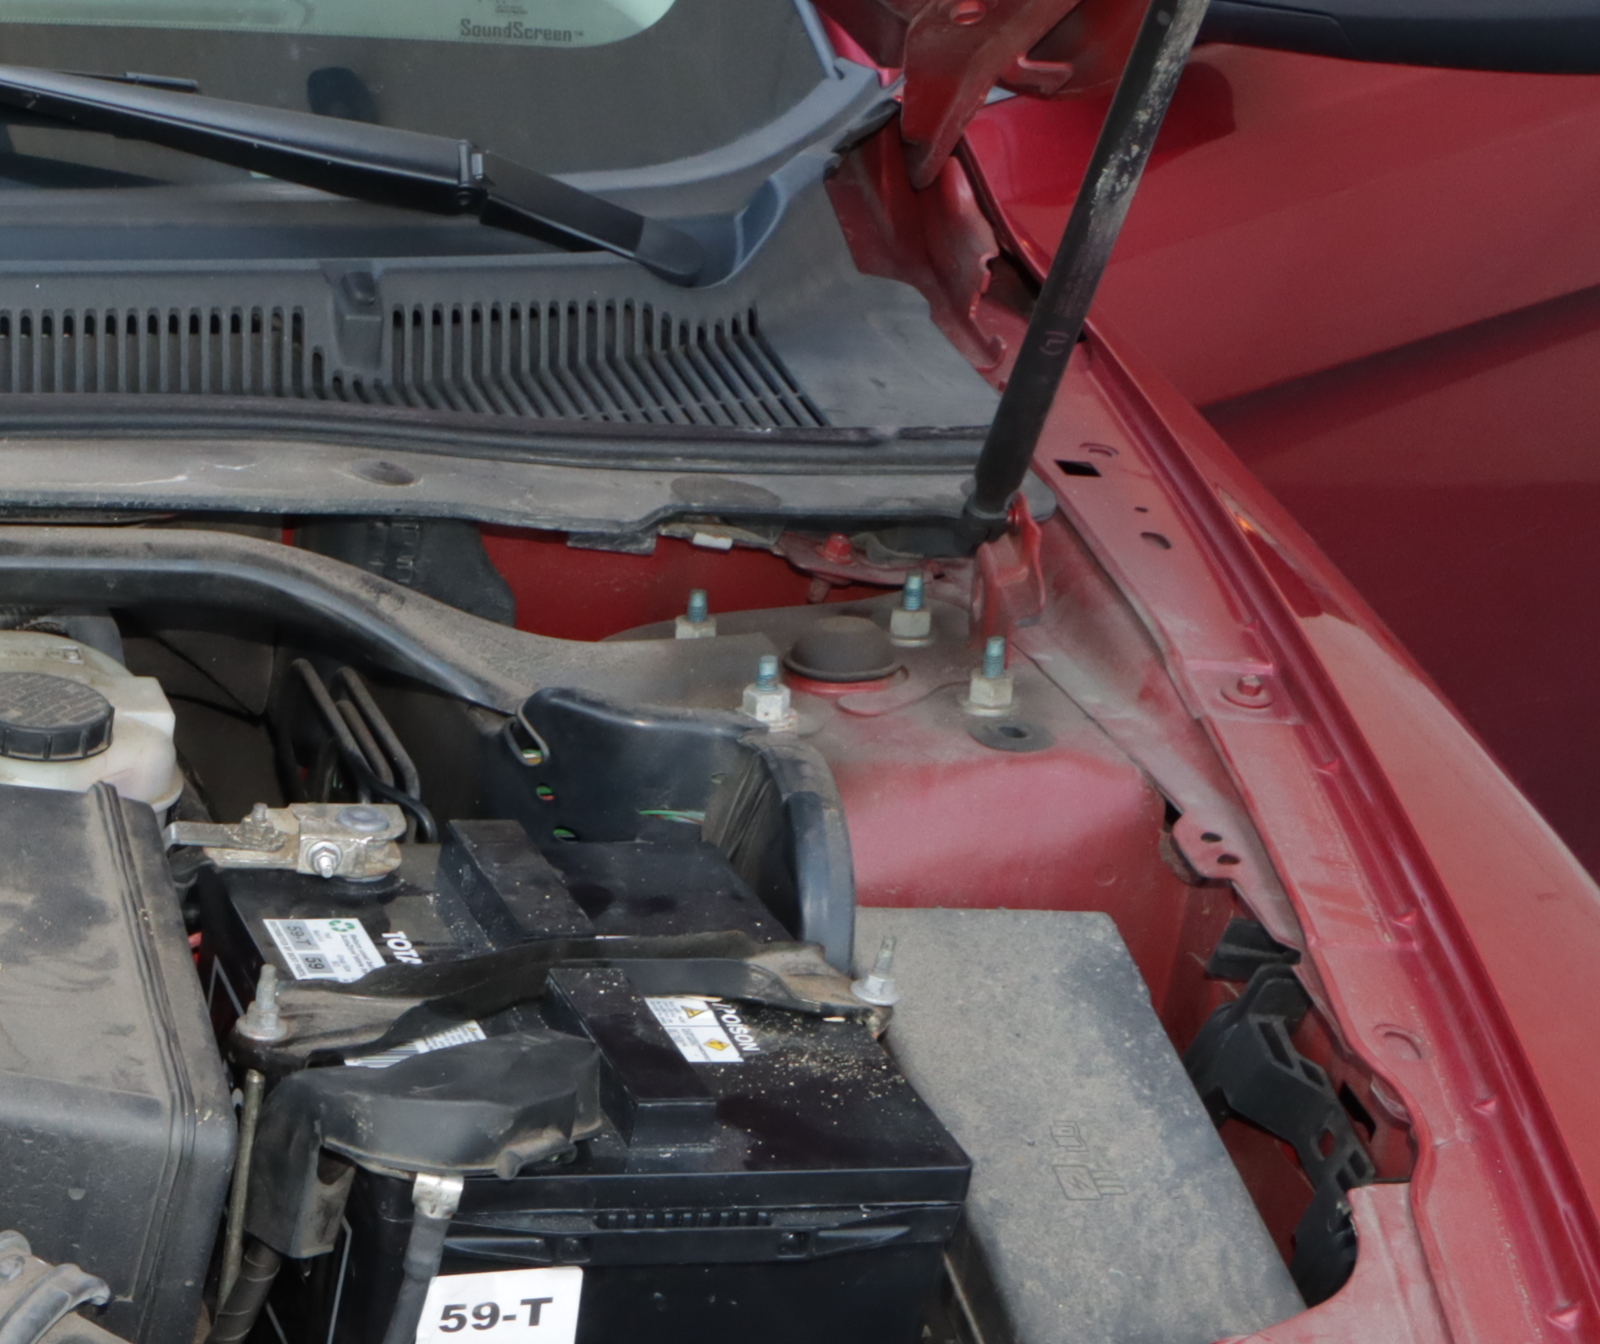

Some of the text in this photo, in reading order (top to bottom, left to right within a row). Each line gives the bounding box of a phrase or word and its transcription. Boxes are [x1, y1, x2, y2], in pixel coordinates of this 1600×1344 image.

[285, 925, 311, 945] 59-T
[304, 957, 326, 969] 59
[438, 1296, 554, 1334] 59-T
